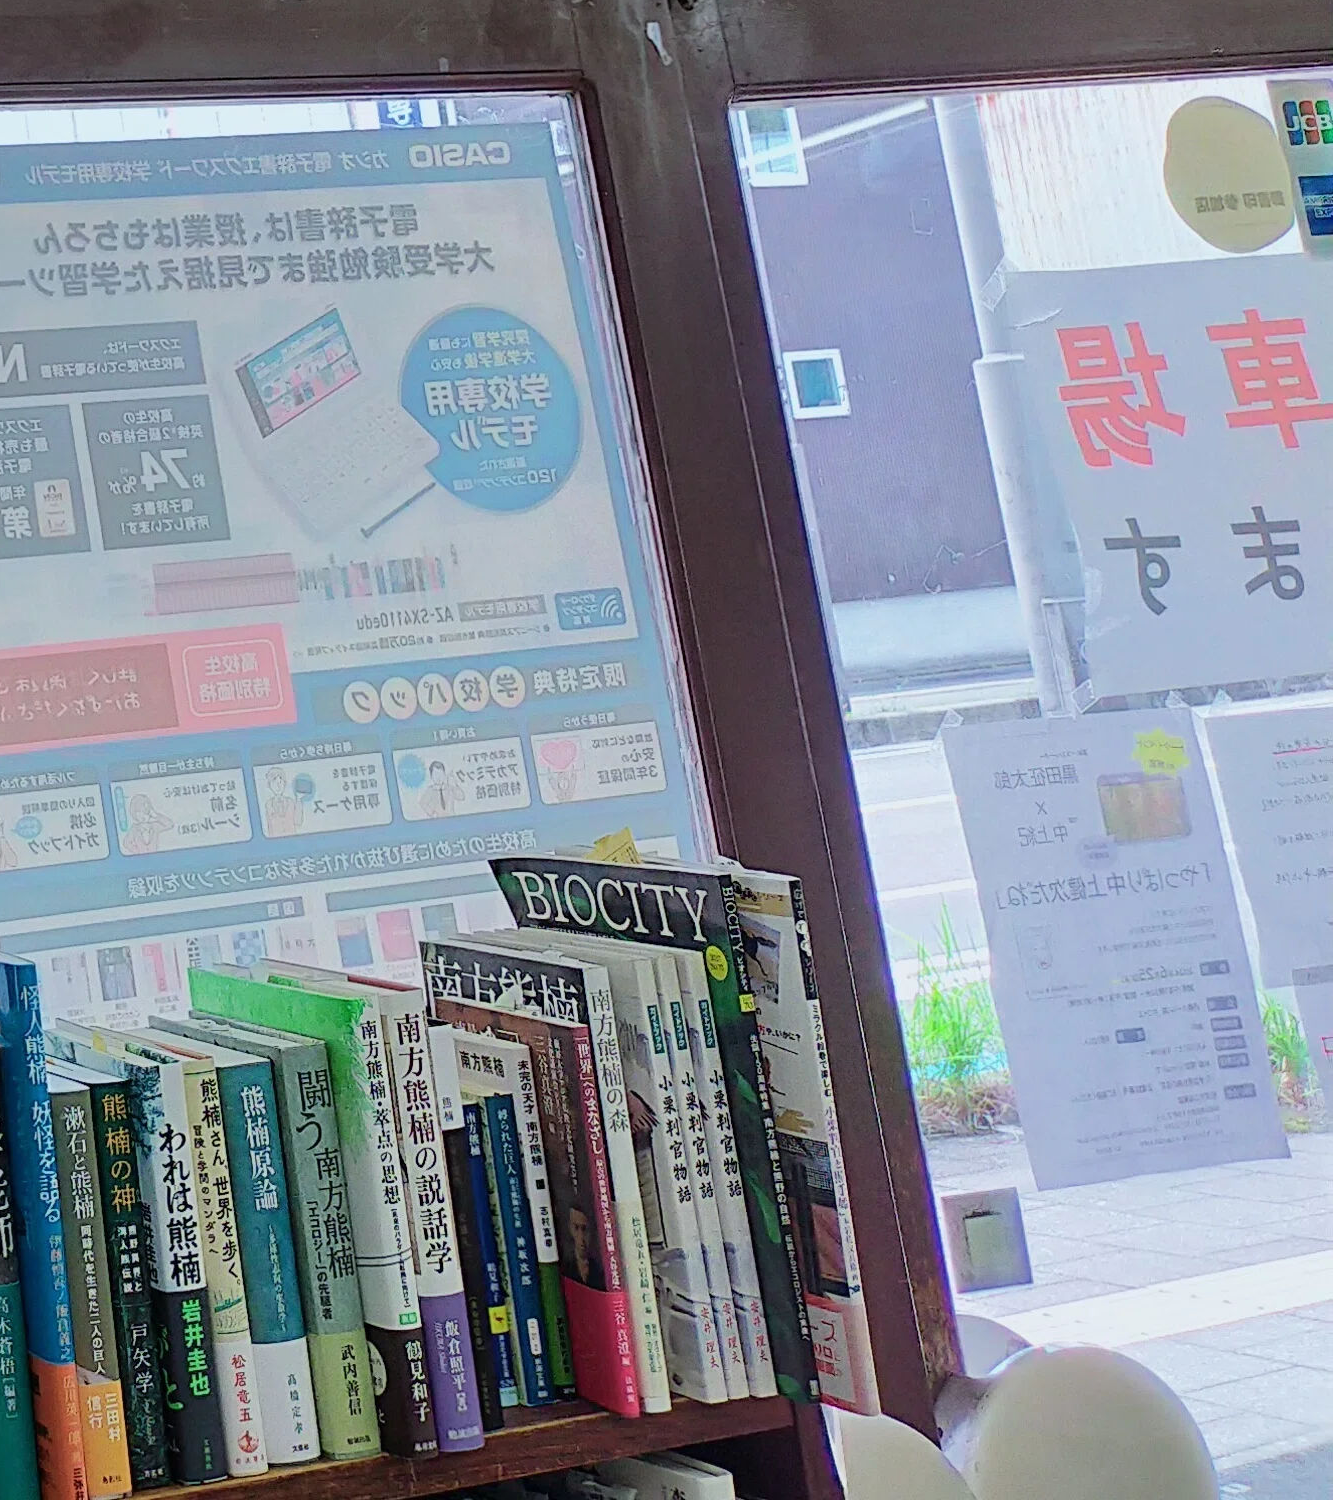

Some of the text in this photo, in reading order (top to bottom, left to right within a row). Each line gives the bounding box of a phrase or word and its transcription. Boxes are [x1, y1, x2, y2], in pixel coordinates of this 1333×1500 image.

[512, 870, 709, 945] BIOCITY
[720, 885, 743, 954] BIOCITY
[458, 1050, 506, 1079] 南方熊楠
[589, 988, 630, 1133] 南方熊楠の森
[62, 1105, 95, 1220] 漱石と熊楠
[102, 1094, 137, 1215] 熊楠の神
[200, 1078, 242, 1286] 熊楠さん、世界を歩く。
[240, 1084, 281, 1211] 熊楠原論
[295, 1069, 356, 1278] 闘う南方熊楠
[394, 1012, 453, 1275] 南方熊楠の説話学
[658, 1074, 694, 1205] 小栗判官物語
[680, 1072, 715, 1201] 小栗判官物語
[708, 1069, 742, 1198] 小栗判官物語
[159, 1121, 201, 1286] われは熊楠
[180, 1299, 211, 1397] 岩井圭也
[231, 1354, 253, 1425] 松居竜五
[340, 1344, 363, 1416] 武内善信
[405, 1340, 431, 1423] 鶴見和子
